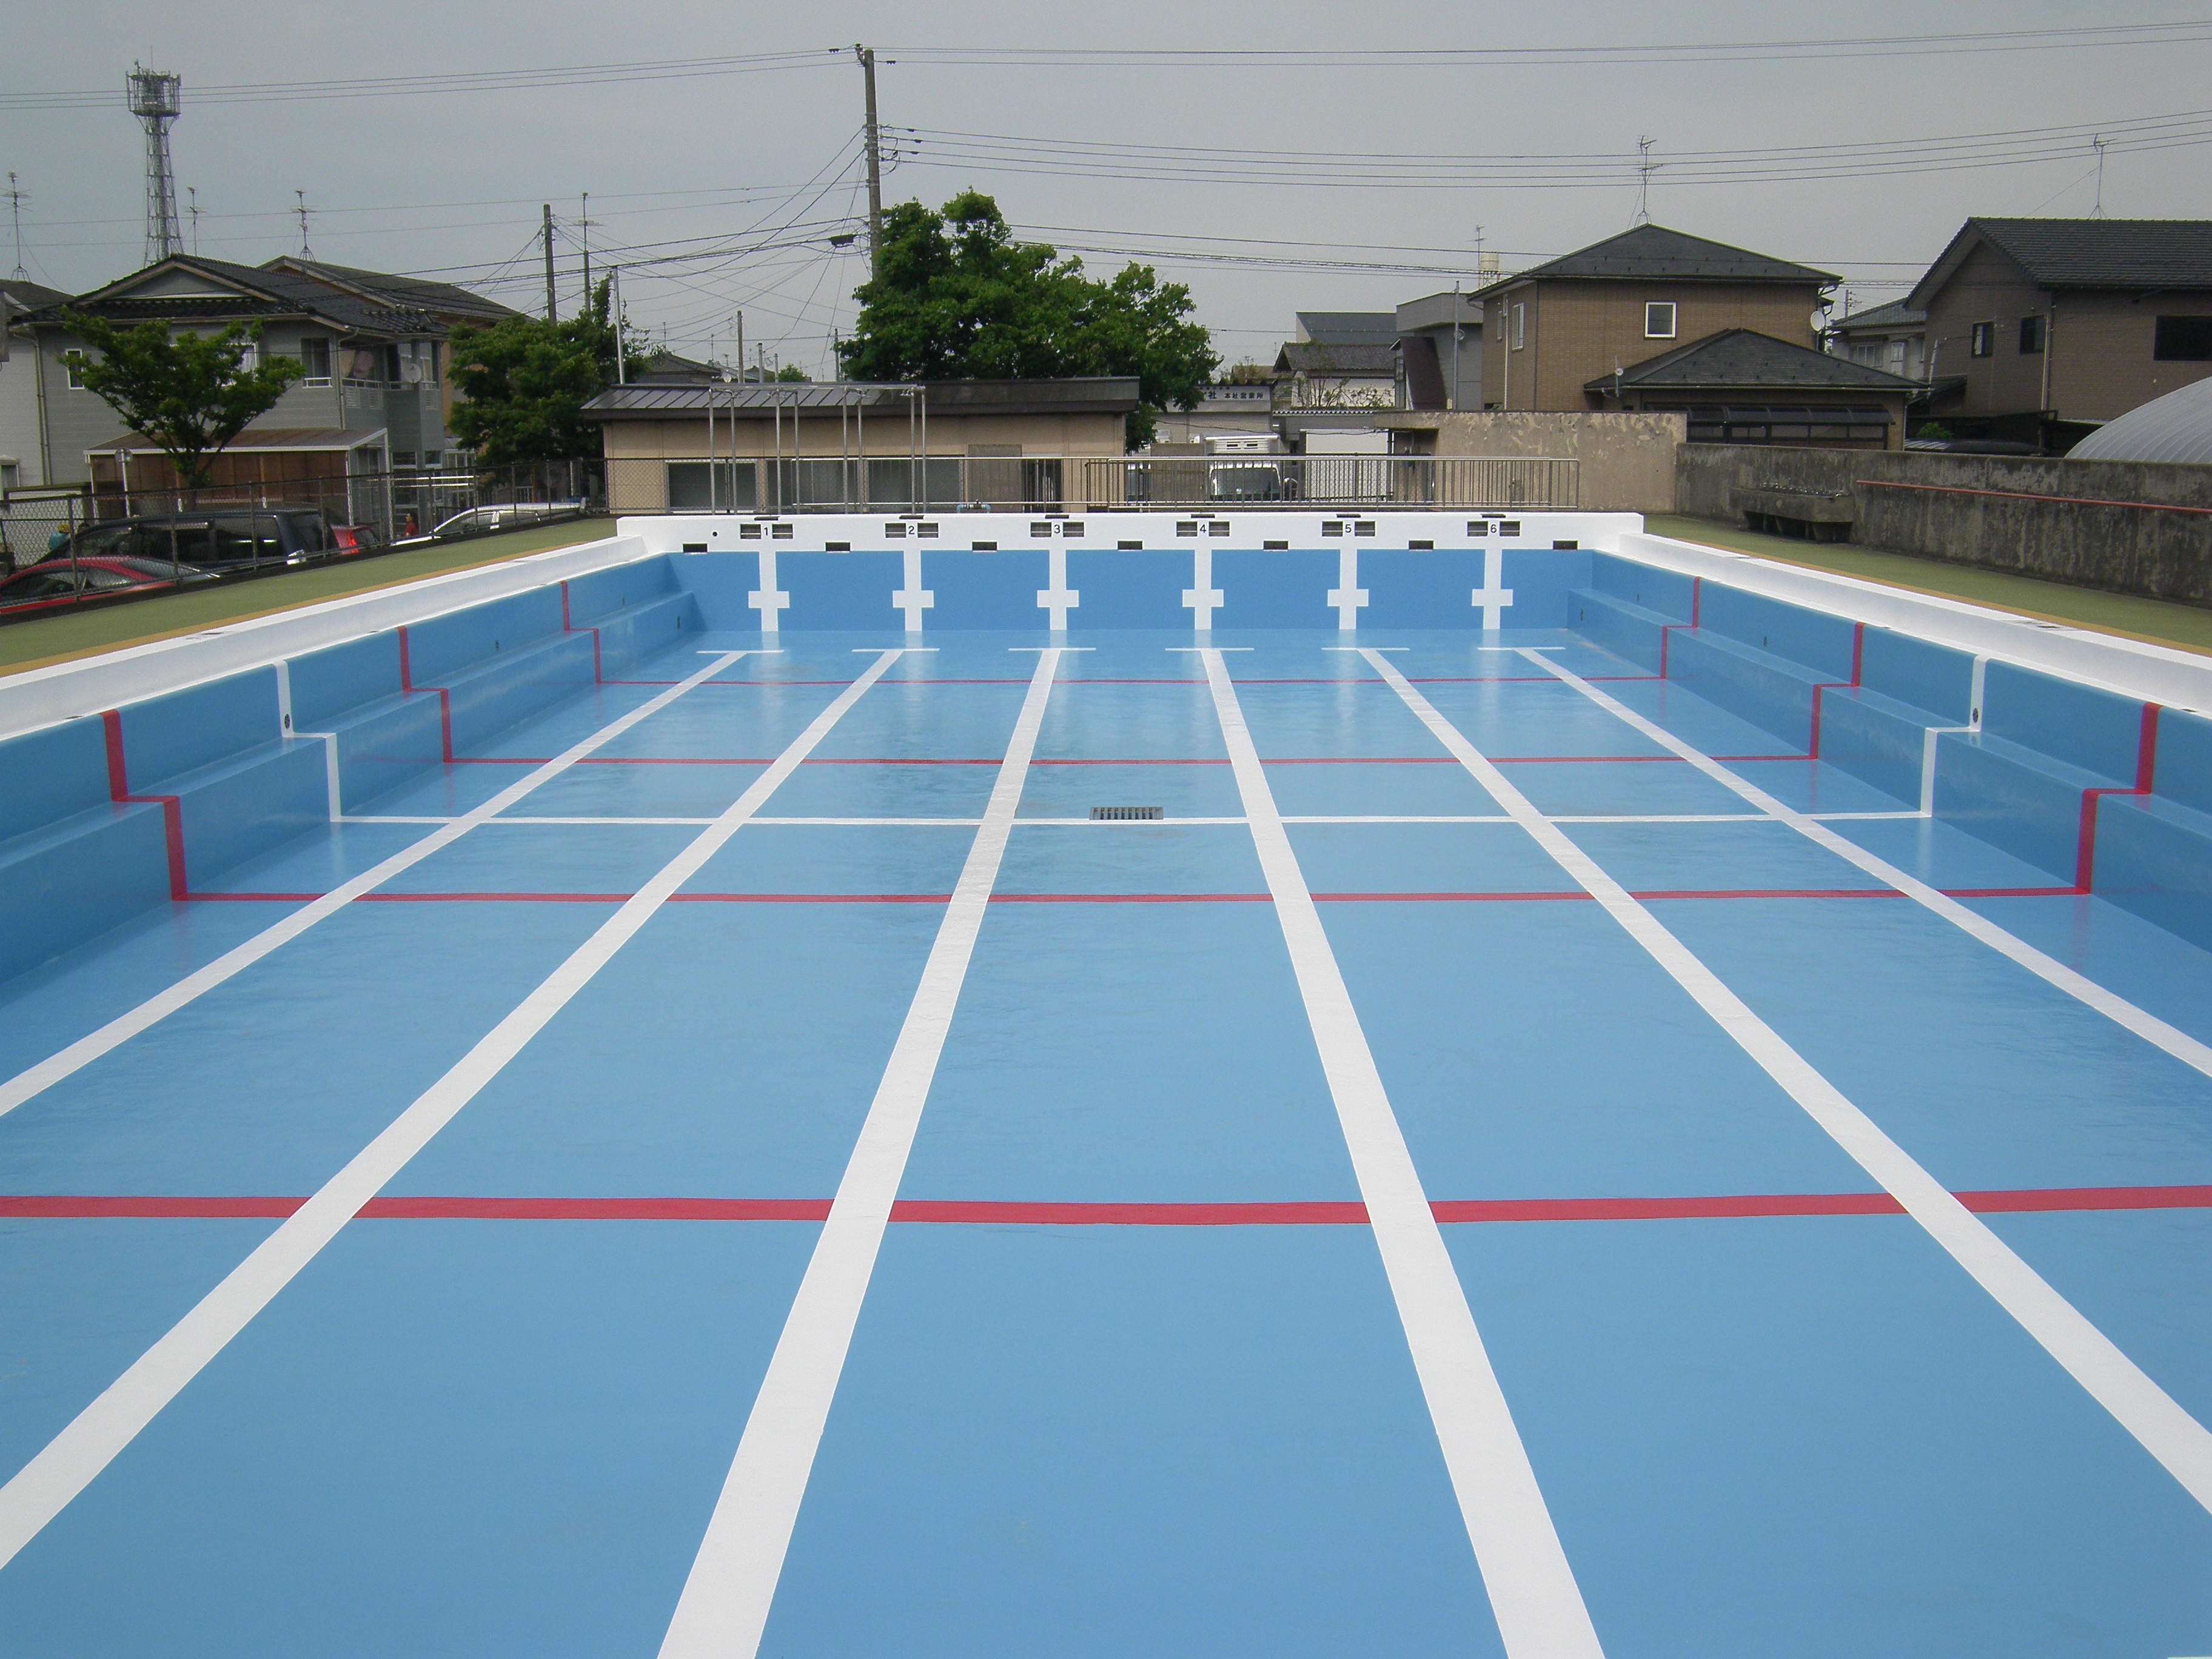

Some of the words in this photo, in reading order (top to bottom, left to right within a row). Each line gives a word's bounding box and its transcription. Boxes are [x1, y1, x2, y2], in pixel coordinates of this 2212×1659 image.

[764, 527, 768, 536] 1
[908, 525, 915, 535] 2
[1054, 524, 1061, 534] 3
[1199, 524, 1207, 534] 4
[1345, 524, 1352, 533] 5
[1490, 524, 1497, 534] 6
